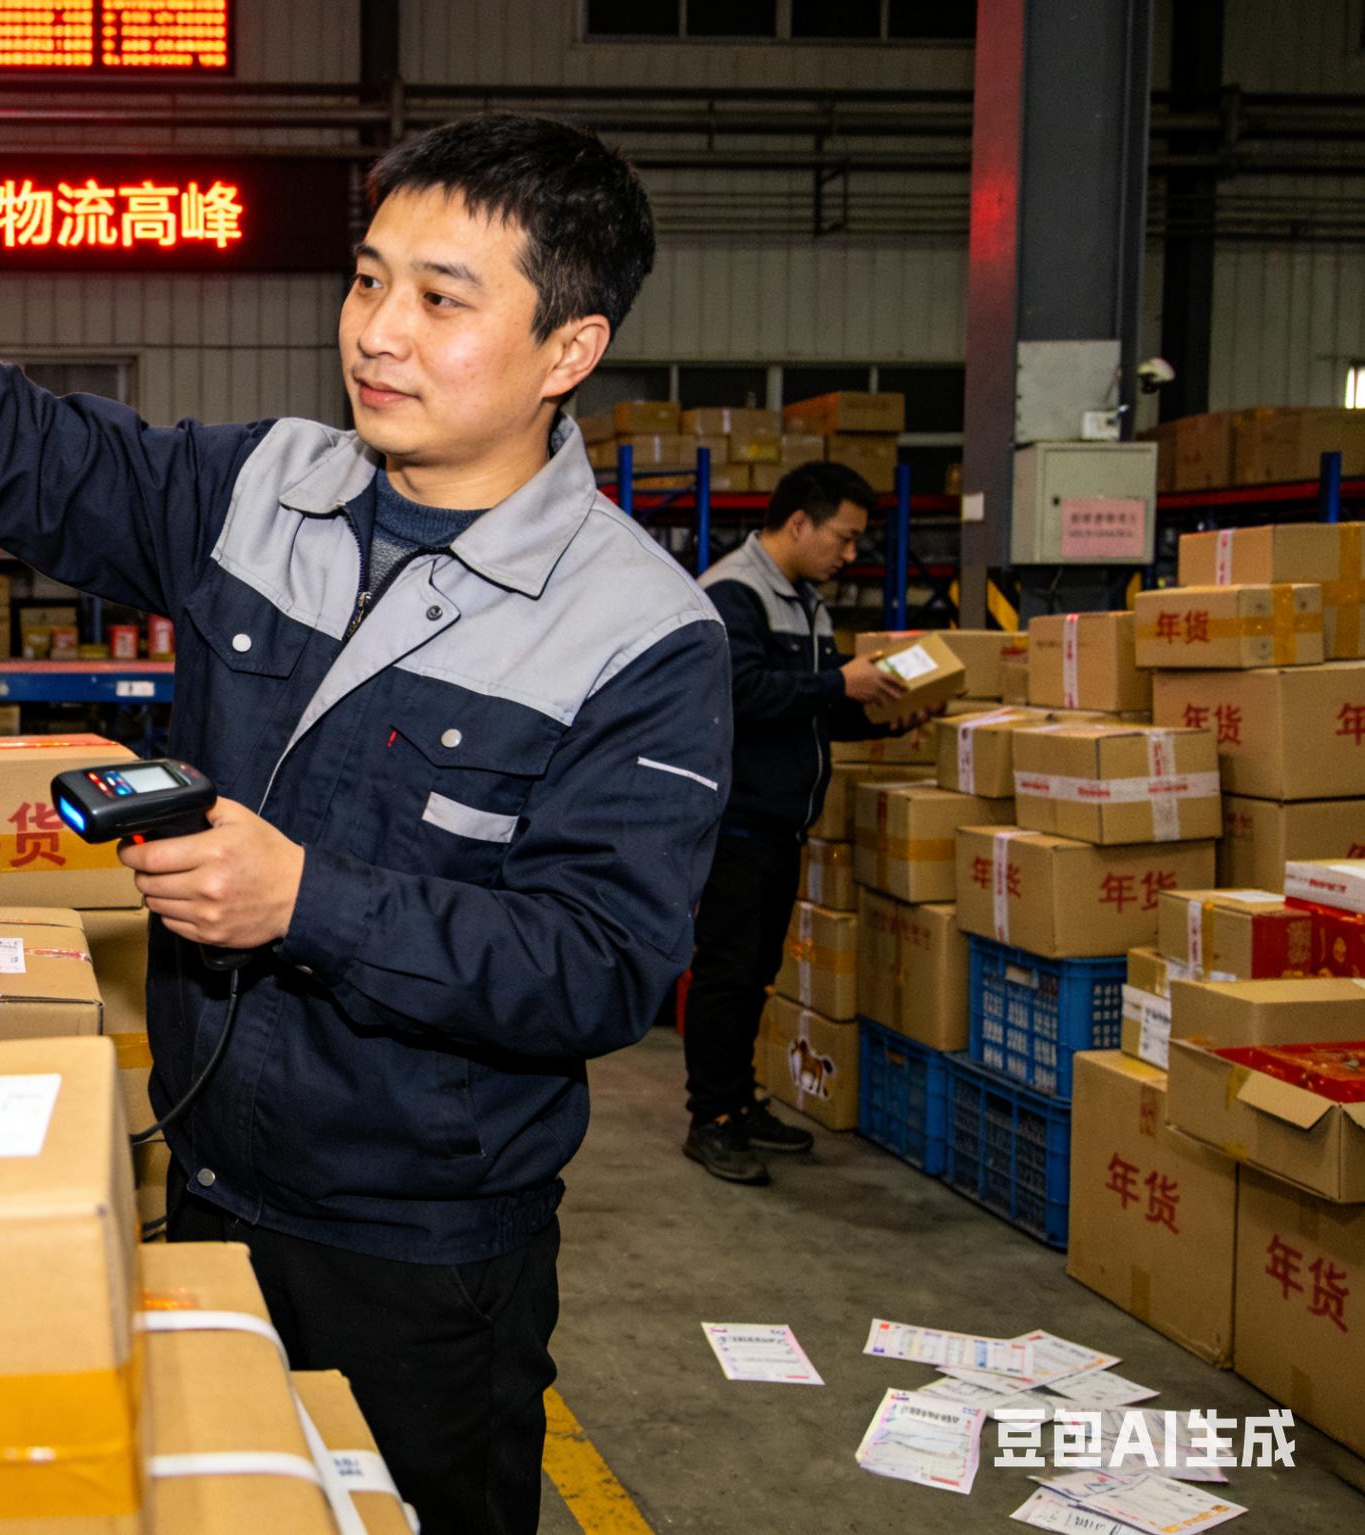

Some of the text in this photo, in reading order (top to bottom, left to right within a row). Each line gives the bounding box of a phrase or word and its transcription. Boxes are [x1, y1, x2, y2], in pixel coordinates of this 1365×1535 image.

[1156, 611, 1210, 645] 年货
[1106, 1152, 1179, 1235] 年货
[1266, 1234, 1350, 1333] 年货
